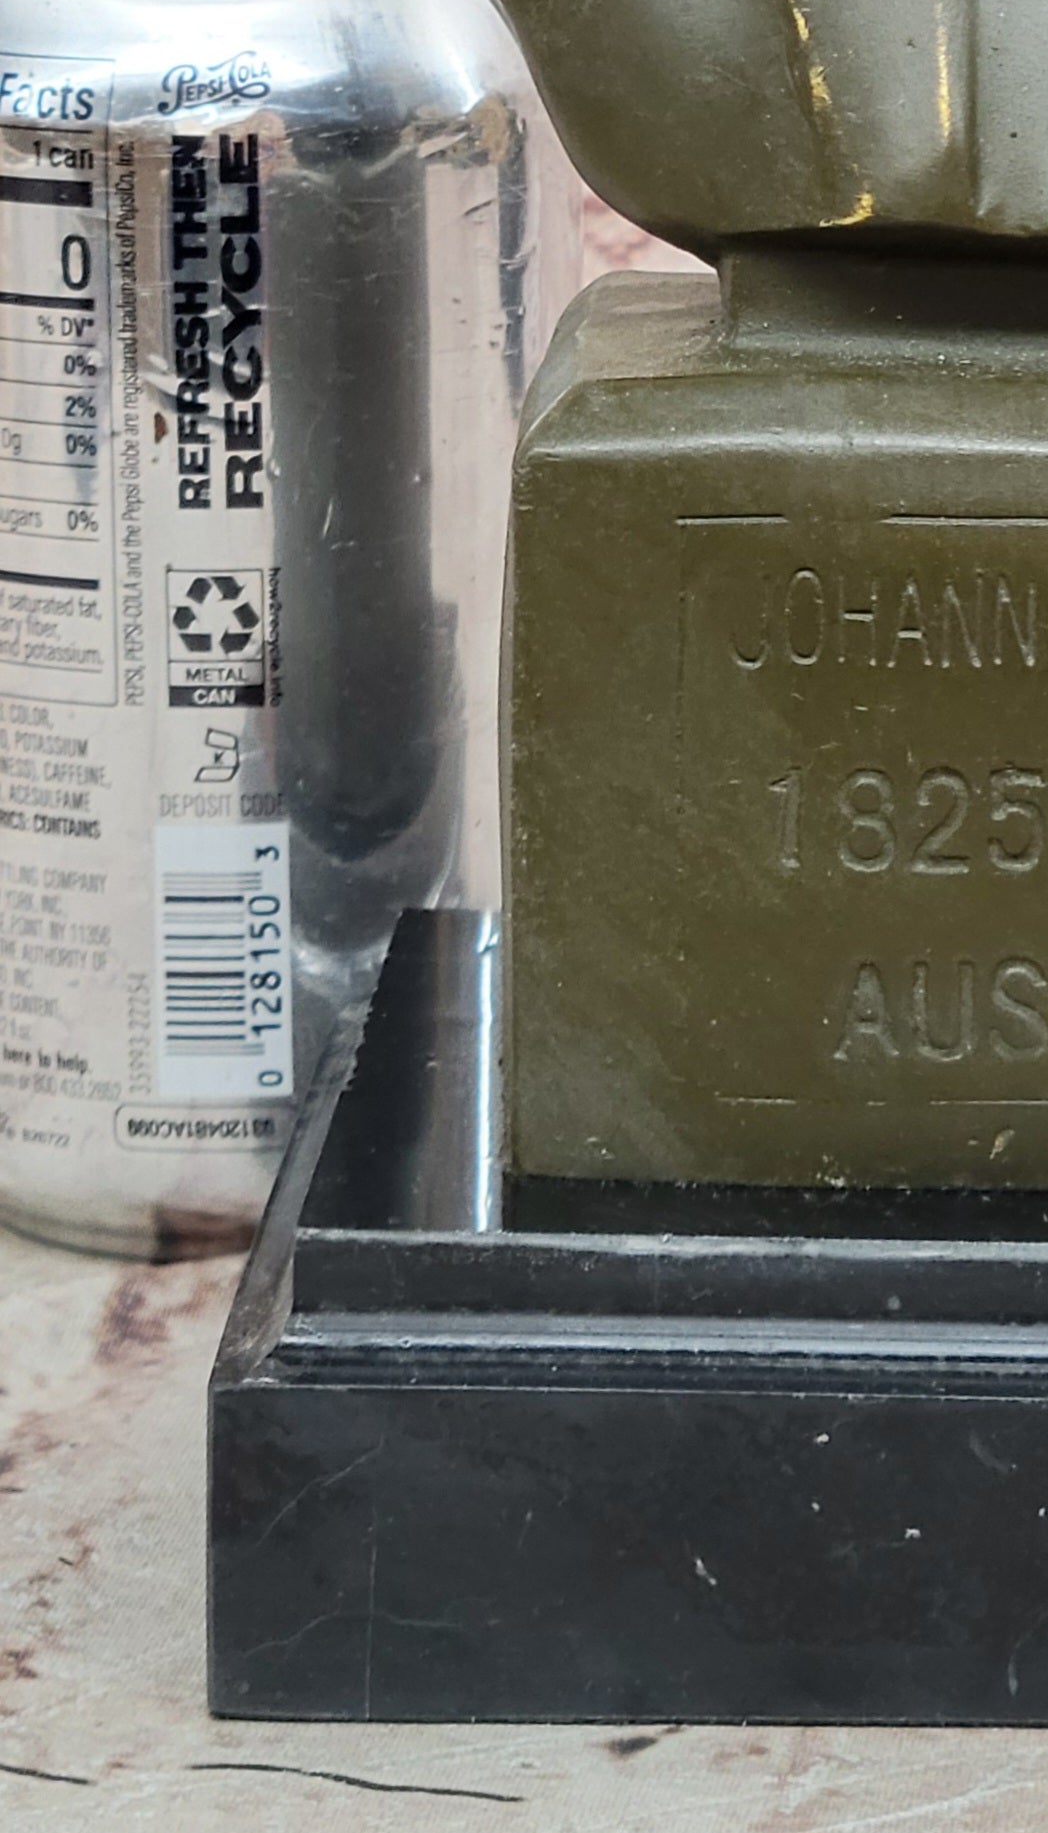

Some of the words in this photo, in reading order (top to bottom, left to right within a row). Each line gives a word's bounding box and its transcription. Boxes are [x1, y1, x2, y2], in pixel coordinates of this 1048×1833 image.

[0, 73, 95, 121] Facts
[33, 139, 42, 167] 1
[49, 146, 95, 170] can
[171, 135, 208, 269] THEN
[115, 232, 136, 248] of
[61, 235, 92, 291] 0
[115, 250, 139, 334] trademarks
[219, 132, 266, 509] RECYCLE
[64, 354, 97, 376] 0%
[116, 336, 143, 410] registered
[65, 396, 97, 418] 2%
[173, 281, 212, 510] REFRESH
[120, 413, 140, 436] are
[66, 434, 97, 457] 0%
[119, 438, 141, 480] Globe
[120, 483, 145, 522] Pepsi
[67, 510, 98, 532] 0%
[121, 525, 142, 548] the
[121, 551, 142, 579] and
[729, 567, 1040, 672] JOHANN
[186, 668, 248, 685] METAL
[192, 688, 236, 706] CAN
[160, 793, 232, 817] DEPOSIT
[240, 793, 286, 818] CODE
[254, 845, 281, 862] 3
[248, 894, 283, 1037] 128150
[258, 1069, 284, 1087] 0
